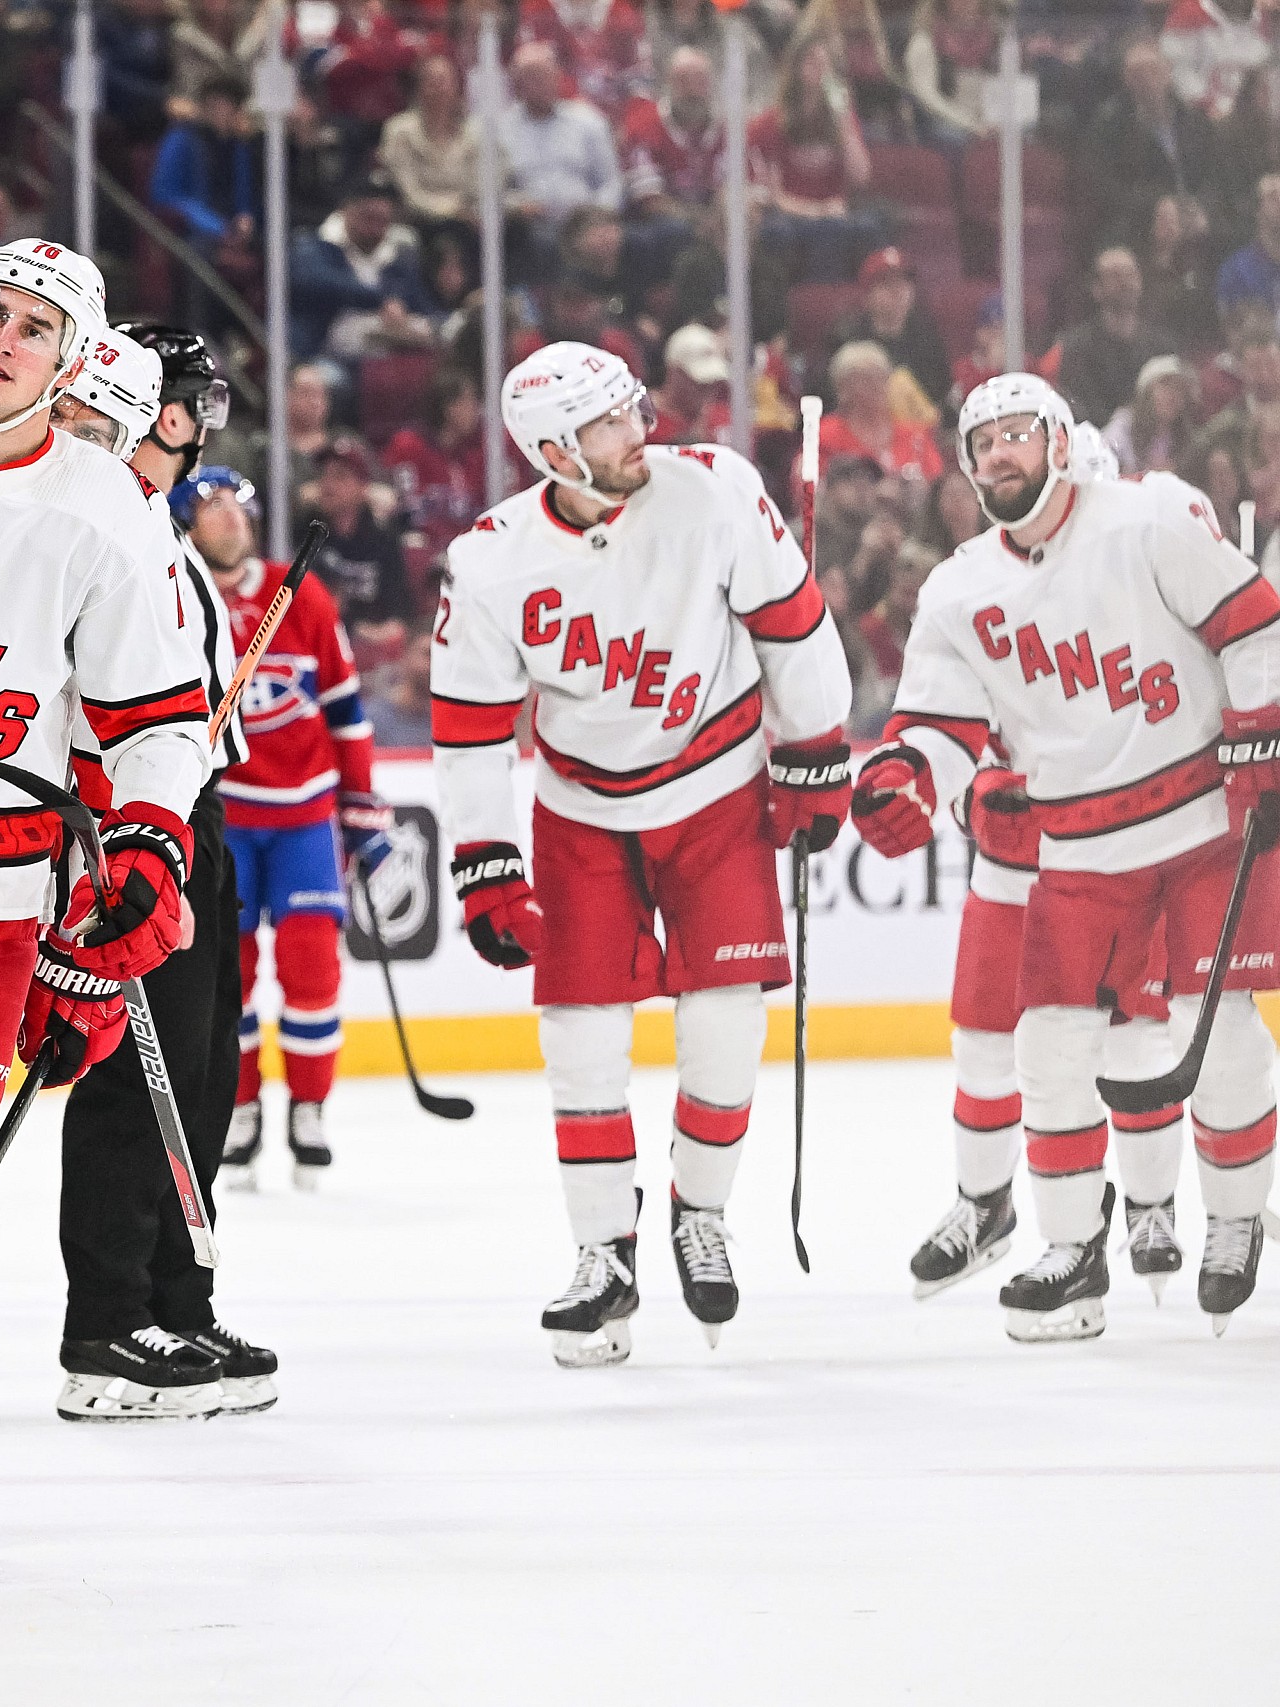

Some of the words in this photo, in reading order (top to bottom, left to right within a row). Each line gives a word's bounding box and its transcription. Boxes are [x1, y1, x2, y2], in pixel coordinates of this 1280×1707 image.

[13, 254, 56, 274] BAUER
[522, 587, 701, 731] CANES
[972, 604, 1181, 725] CANES
[770, 762, 851, 786] BAUE
[453, 857, 523, 893] AUER
[1194, 952, 1275, 975] BUER
[125, 1001, 170, 1094] BAUER
